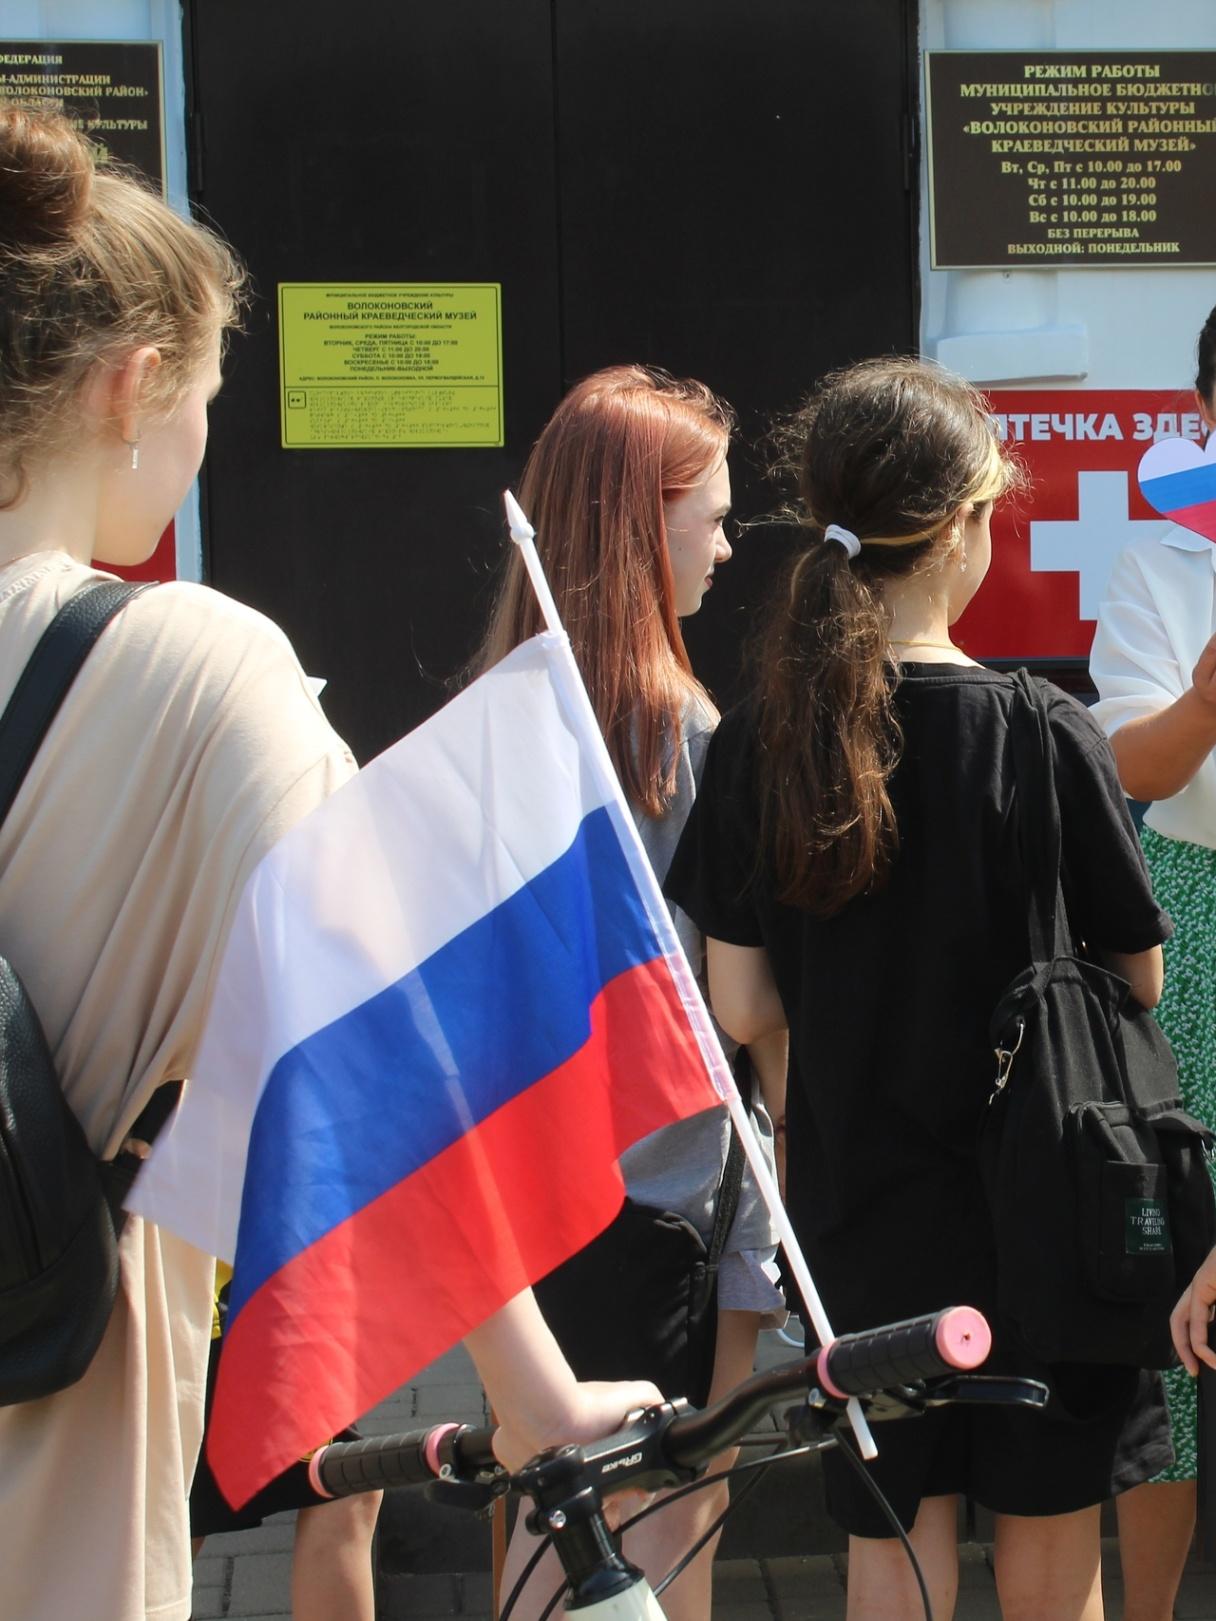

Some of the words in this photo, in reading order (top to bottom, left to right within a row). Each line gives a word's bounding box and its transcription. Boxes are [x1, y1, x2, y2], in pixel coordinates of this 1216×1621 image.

[1024, 65, 1087, 78] РЕЖИМ
[1091, 65, 1161, 78] РАБОТЫ
[960, 84, 1112, 99] МУНИЦИПАЛЬНОЕ
[990, 102, 1103, 117] УЧРЕЖДЕНИЕ
[1106, 101, 1196, 115] КУЛЬТУРЫ
[963, 118, 1124, 135] «ВОЛОКОНОВСКИЙ
[991, 137, 1130, 155] КРАЕВЕДЧЕСКИЙ
[1133, 136, 1197, 152] МУЗЕЙ»
[1001, 161, 1024, 175] Вт,
[1027, 161, 1050, 176] Ср,
[1053, 161, 1073, 174] Пт
[1075, 163, 1084, 173] с
[1087, 160, 1123, 173] 10.00
[1126, 162, 1143, 174] до
[1146, 159, 1182, 173] 17.00
[1027, 177, 1047, 190] Чт
[1050, 179, 1058, 189] с
[1061, 177, 1097, 190] 11.00
[1100, 178, 1117, 191] до
[1120, 176, 1157, 189] 20.00
[1028, 193, 1047, 206] Сб
[1050, 196, 1058, 206] с
[1062, 193, 1098, 206] 10.00
[1100, 195, 1117, 207] до
[1121, 193, 1157, 206] 19.00
[1029, 210, 1047, 223] Вс
[1051, 213, 1059, 223] с
[1062, 210, 1098, 223] 10.00
[1101, 212, 1117, 224] до
[1121, 209, 1157, 222] 18.00
[1047, 227, 1070, 238] БЕЗ
[1073, 227, 1140, 238] ПЕРЕРЫВА
[1007, 242, 1085, 255] ВЫХОДНОЙ:
[1087, 241, 1181, 254] ПОНЕДЕЛЬНИК
[347, 301, 433, 310] ВОЛОКОНОВСКИЙ
[303, 311, 359, 321] РАЙОННЫЙ
[361, 311, 443, 321] КРАЕВЕДЧЕСКИЙ
[444, 311, 477, 320] МУЗЕЙ
[1132, 412, 1209, 442] ЗДЕ
